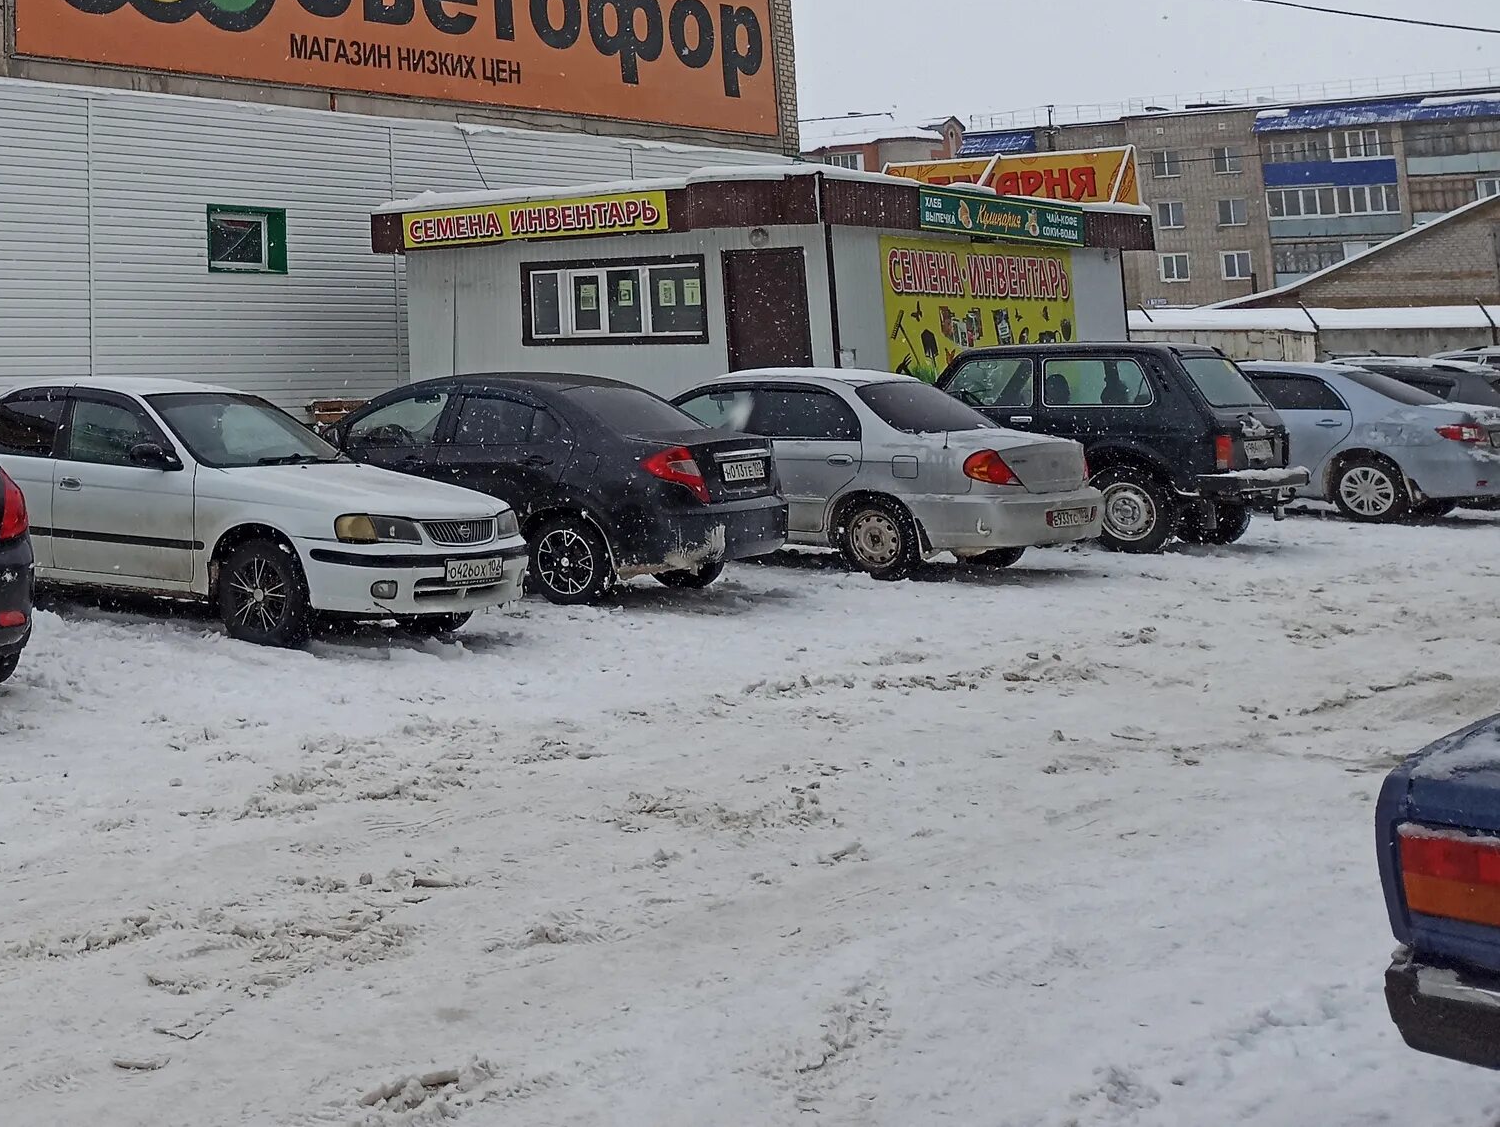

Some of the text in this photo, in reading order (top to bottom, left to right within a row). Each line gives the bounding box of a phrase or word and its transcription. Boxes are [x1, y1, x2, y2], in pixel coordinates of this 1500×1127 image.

[289, 32, 522, 86] МАГАЗИН НИЗКИХ ЦЕН
[924, 196, 942, 209] ХЛЕБ
[925, 211, 956, 225] ВЫПЕЧКА
[976, 203, 1021, 232] Кулинария
[408, 199, 659, 243] СЕМЕНА ИНВЕНТАРЬ
[888, 247, 1070, 300] СЕМЕНА ИНВЕНТАРЬ
